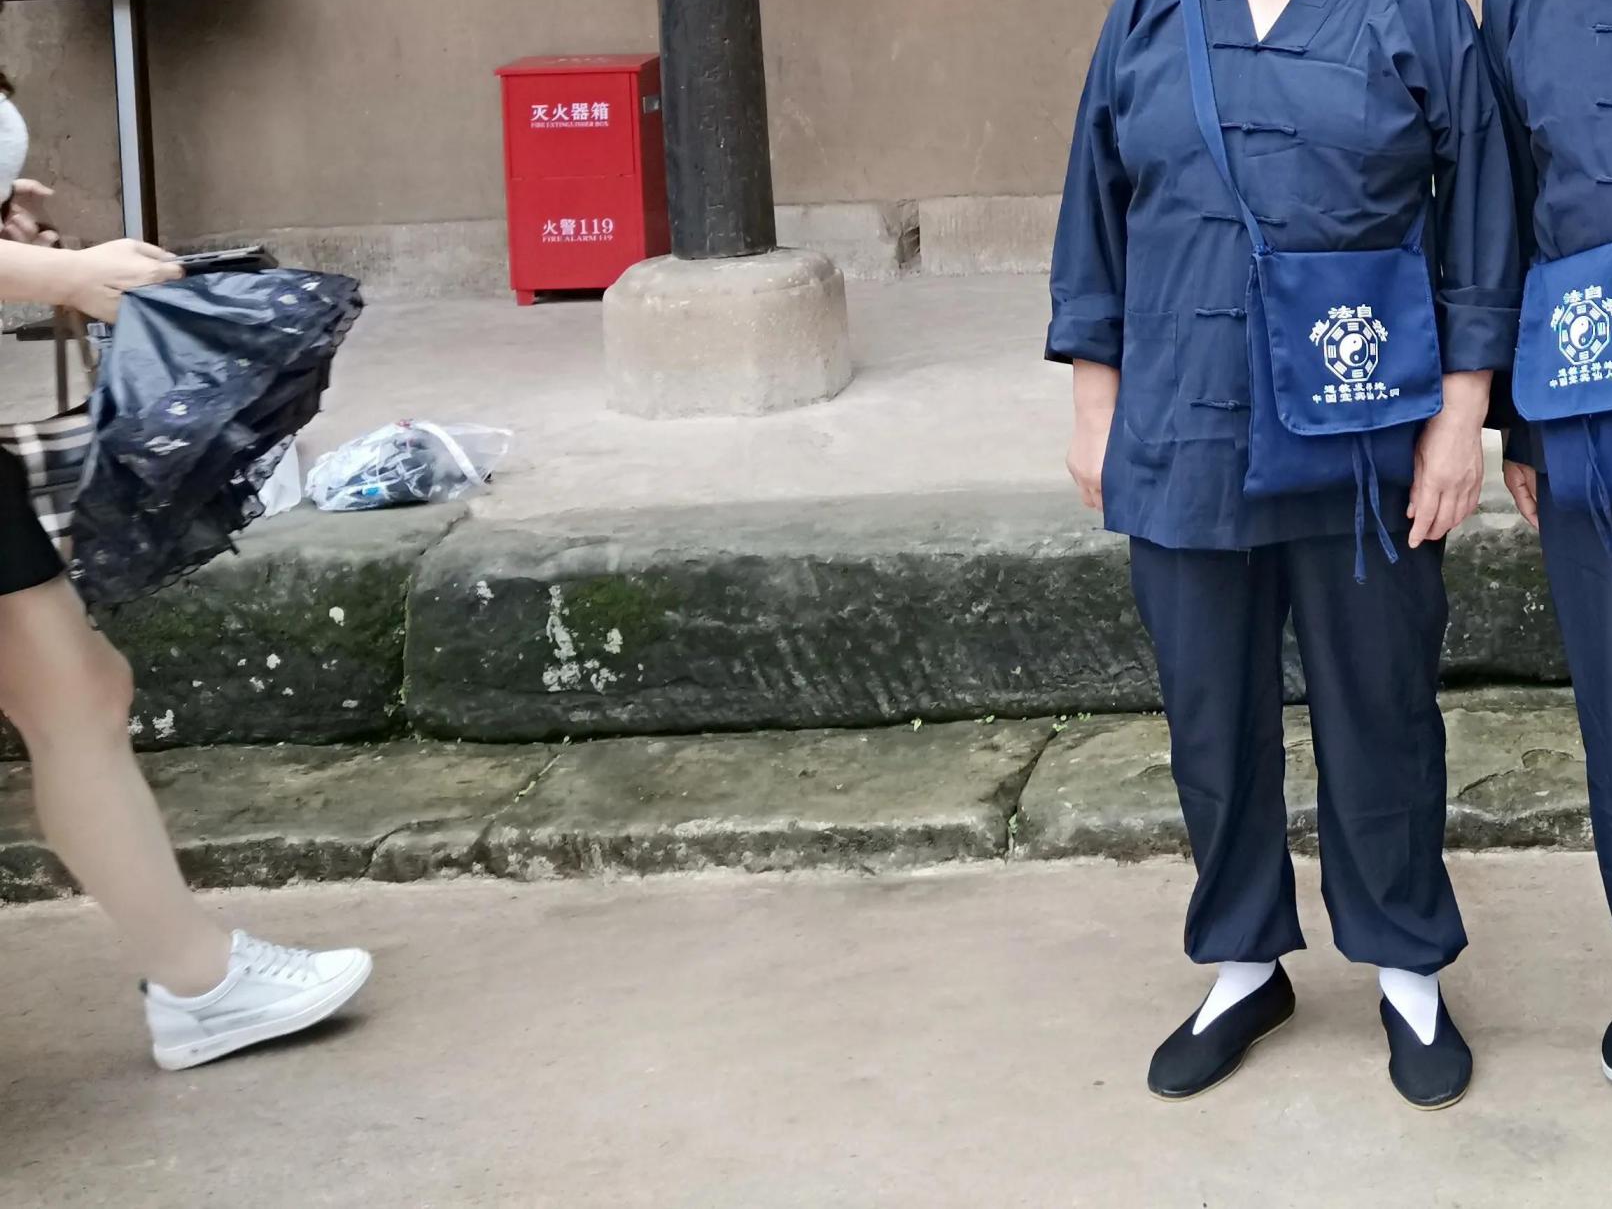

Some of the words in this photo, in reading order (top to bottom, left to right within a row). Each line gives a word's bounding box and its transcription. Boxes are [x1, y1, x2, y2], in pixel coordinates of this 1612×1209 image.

[530, 101, 610, 122] 灭火器箱
[542, 217, 614, 236] 火警119
